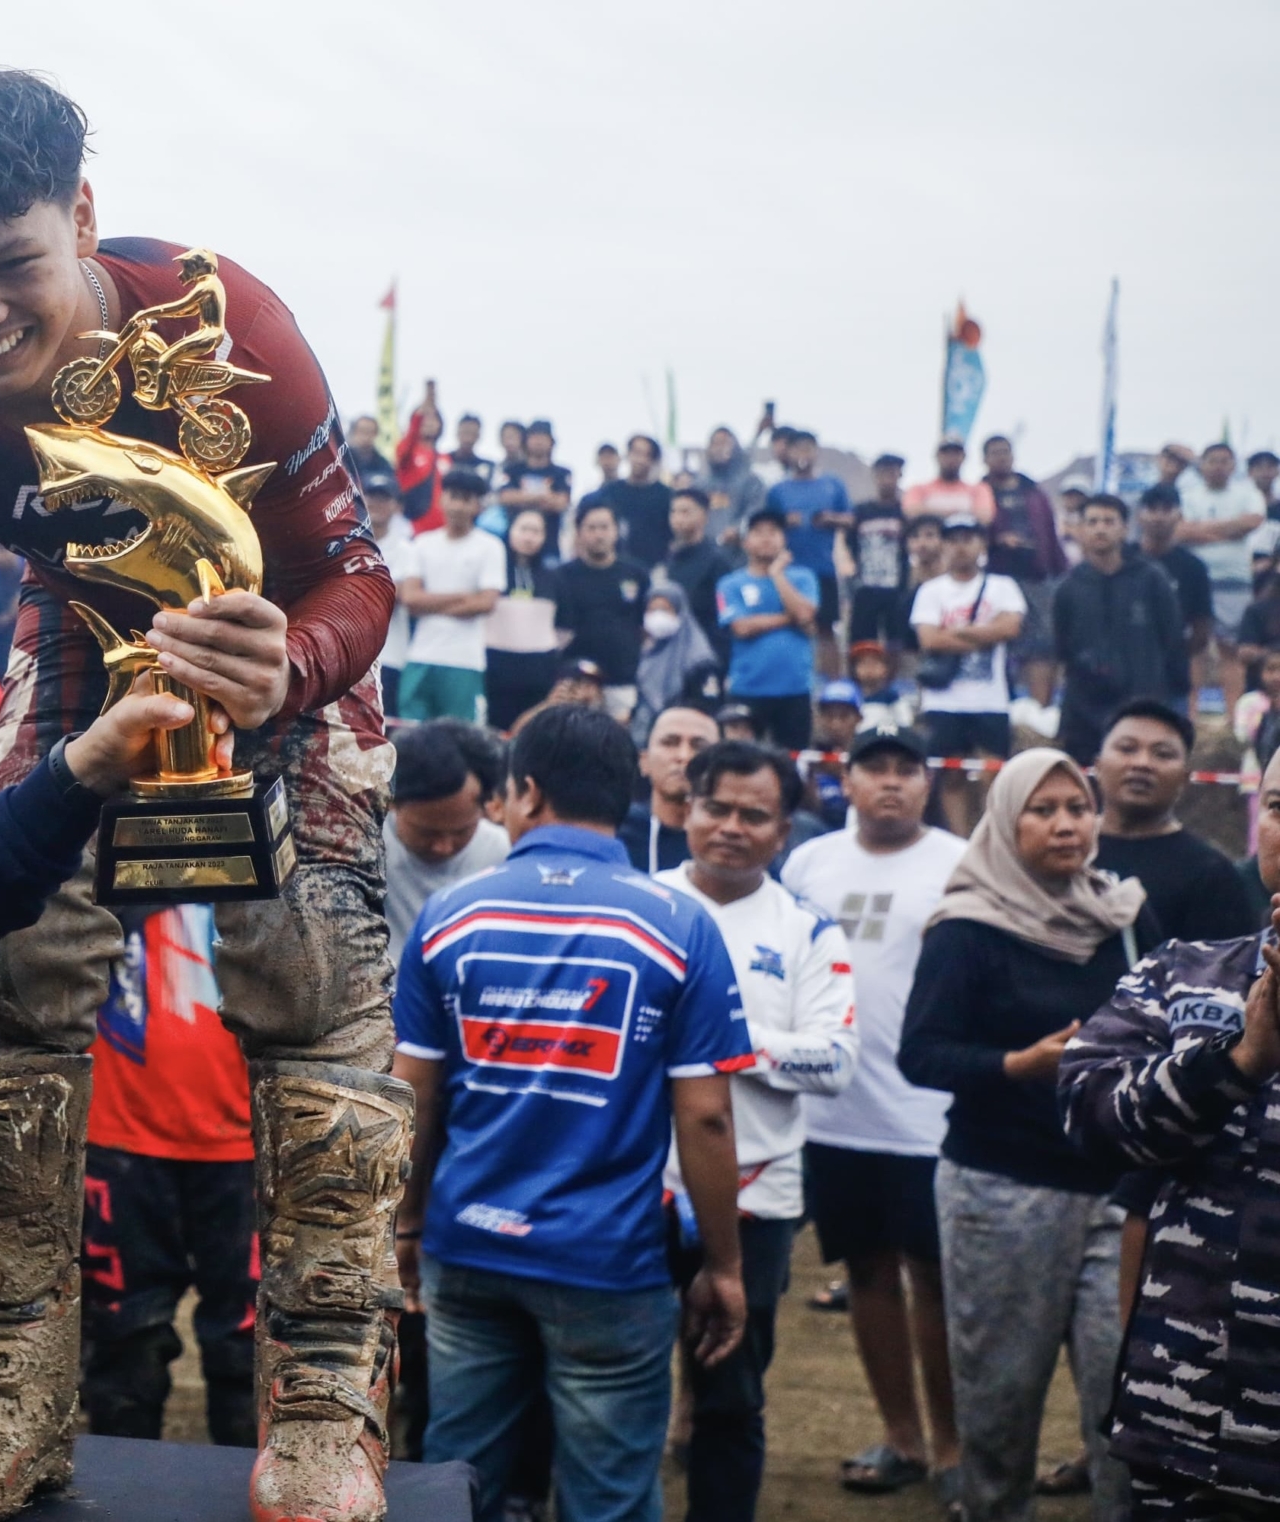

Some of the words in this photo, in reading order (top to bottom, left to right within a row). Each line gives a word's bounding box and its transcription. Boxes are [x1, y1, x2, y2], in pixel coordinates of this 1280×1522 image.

[163, 817, 205, 825] TANJAKAN
[168, 826, 192, 834] HUDA
[165, 861, 206, 869] TANJAKAN
[207, 860, 225, 868] 2023
[582, 977, 609, 1011] 7
